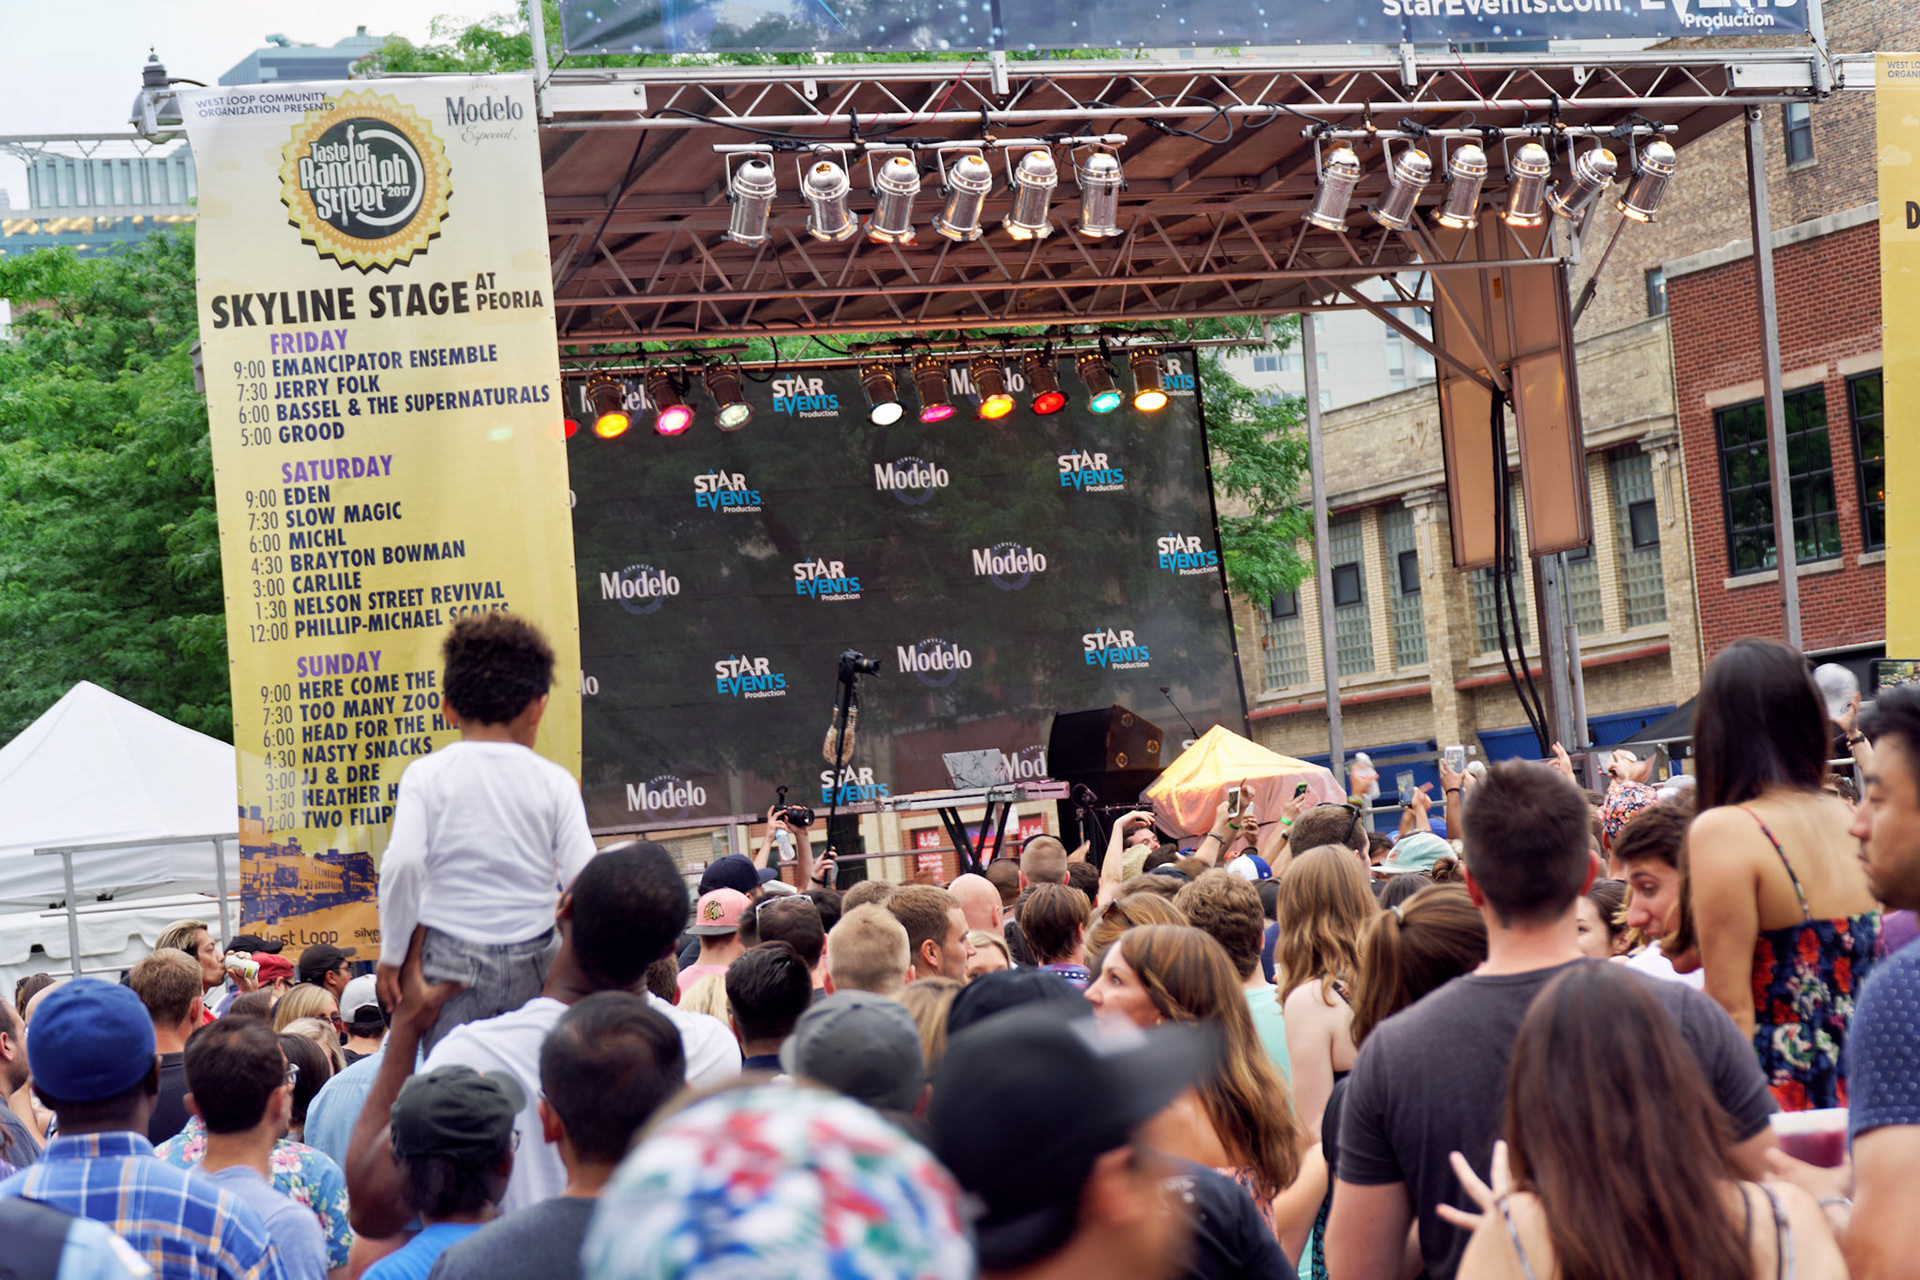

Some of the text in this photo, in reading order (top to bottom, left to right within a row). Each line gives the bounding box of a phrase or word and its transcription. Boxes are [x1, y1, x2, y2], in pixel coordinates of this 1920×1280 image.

[1685, 9, 1775, 28] Production
[1887, 61, 1909, 69] WEST
[196, 92, 326, 108] WEST LOOP COMMUNITY
[199, 102, 335, 117] ORGANIZATION PRESENTS
[445, 95, 523, 126] Modelo
[310, 142, 371, 162] Taste of
[299, 153, 409, 189] Randolph
[316, 186, 411, 220] Street 2017
[475, 272, 496, 290] AT
[211, 281, 544, 328] SKYLINE STAGE PEORIA
[270, 329, 348, 354] FRIDAY
[234, 344, 498, 380] 9:00 EMANCIPATOR ENSEMBLE
[237, 375, 381, 402] 7:30 JERRY FOLK
[772, 375, 825, 398] STAR
[239, 385, 551, 424] 6:00 BASSEL & THE SUPERNATURALS
[774, 394, 839, 417] EVENTS
[799, 409, 839, 418] Production
[241, 421, 345, 447] 5:00 GROOD
[281, 454, 393, 484] SATURDAY
[1058, 449, 1110, 473] STAR
[694, 469, 747, 493] STAR
[874, 462, 950, 491] Modelo
[1060, 467, 1124, 491] EVENTS
[1086, 483, 1124, 492] Production
[245, 485, 331, 509] 9:00 EDEN
[696, 489, 761, 512] EVENTS
[723, 505, 762, 513] Production
[248, 501, 402, 531] 7:30 SLOW MAGIC
[249, 529, 347, 553] 6:00 MICHL
[1158, 532, 1202, 555] STAR
[251, 539, 466, 576] 4:30 BRAYTON BOWMAN
[793, 558, 846, 581] STAR
[972, 546, 1047, 576] Modelo
[1159, 550, 1218, 574] EVENTS
[1179, 565, 1219, 576] Production
[253, 572, 362, 598] 3:00 CARLILE
[600, 569, 681, 600] Modelo
[796, 577, 861, 600] EVENTS
[255, 581, 505, 620] 1:30 NELSON STREET REVIVAL
[821, 592, 860, 602] Production
[250, 623, 289, 643] 12:00
[295, 608, 443, 639] PHILLIP-MICHAEL
[1082, 627, 1137, 651] STAR
[297, 650, 382, 678] SUNDAY
[715, 654, 771, 679] STAR
[897, 643, 972, 673] Modelo
[1085, 645, 1150, 669] EVENTS
[1112, 660, 1150, 670] Production
[260, 670, 436, 703] 9:00 HERE COME THE
[716, 673, 787, 698] EVENTS
[744, 689, 786, 699] Production
[263, 706, 293, 726] 7:30
[300, 701, 336, 723] TOO
[343, 696, 395, 719] MANY
[263, 728, 295, 748] 6:00
[302, 722, 348, 744] HEAD
[355, 719, 388, 740] FOR
[394, 715, 426, 736] THE
[264, 736, 433, 770] 4:30 NASTY SNACKS
[265, 763, 381, 792] 3:00 JJ & DRE
[820, 764, 875, 788] STAR
[268, 792, 295, 813] 1:30
[302, 785, 381, 807] HEATHER
[626, 780, 707, 812] Modelo
[822, 783, 890, 808] EVENTS
[302, 810, 343, 829] TWO
[300, 928, 339, 948] Loop
